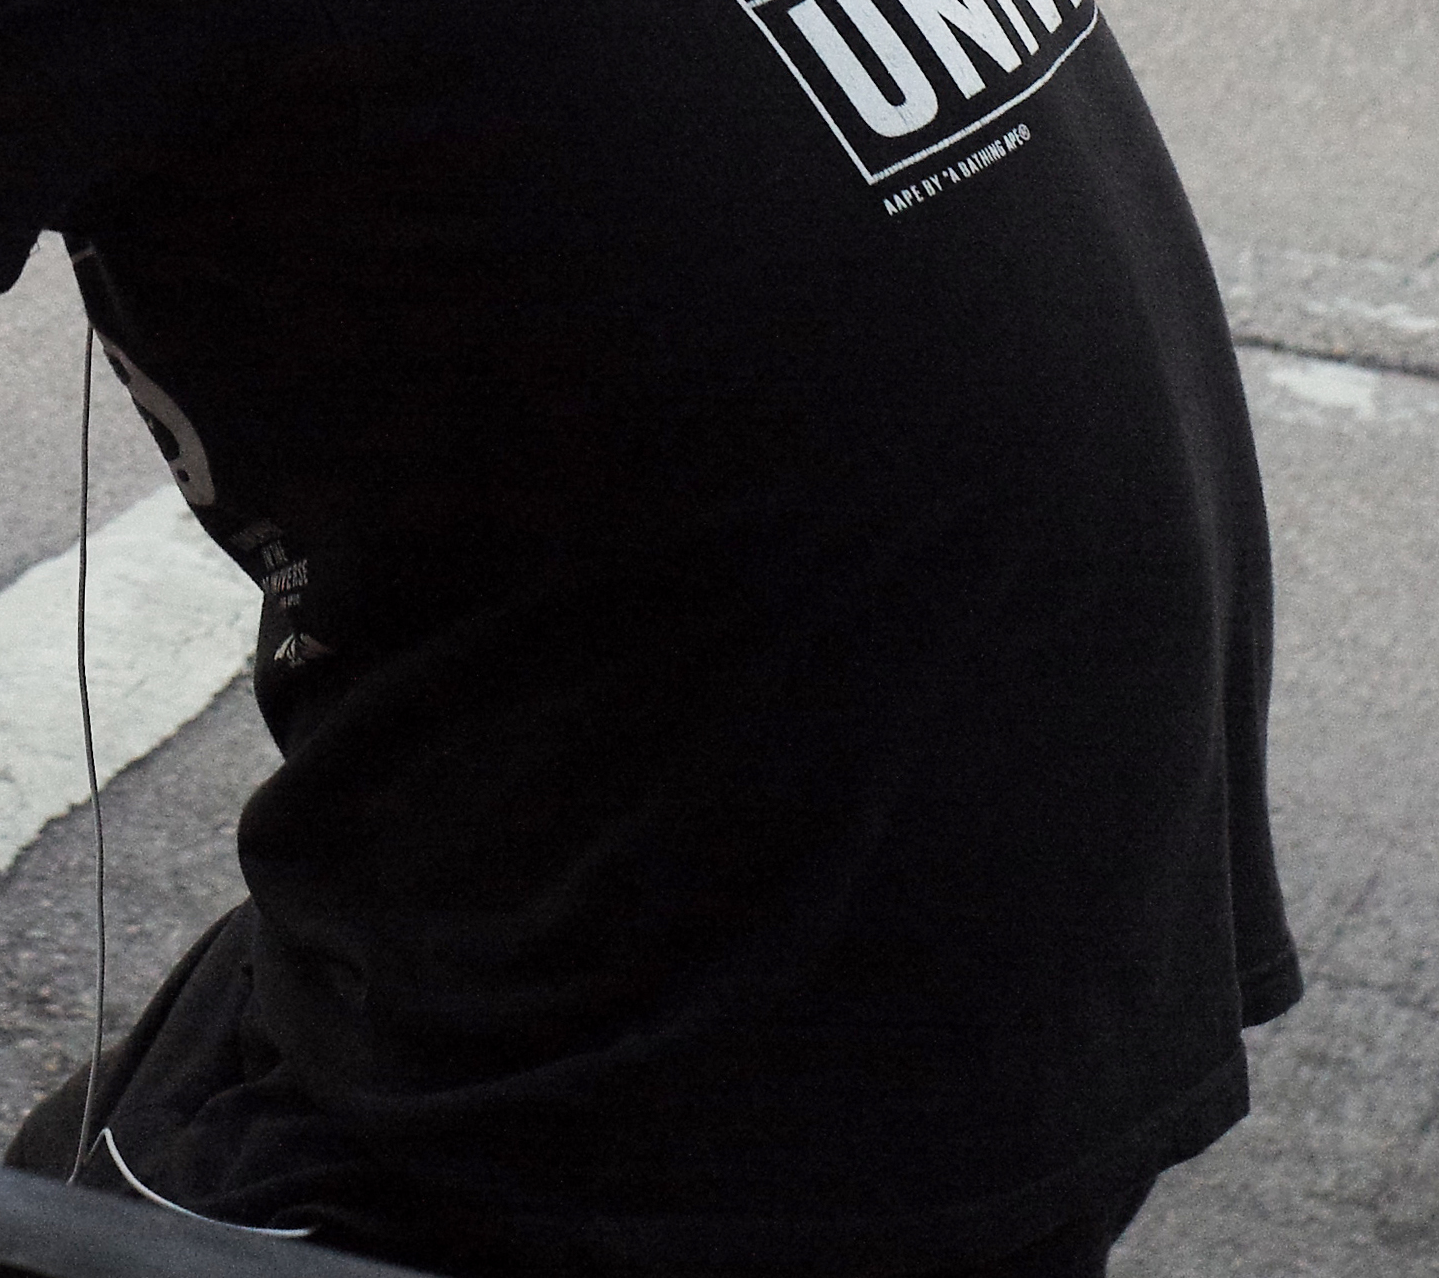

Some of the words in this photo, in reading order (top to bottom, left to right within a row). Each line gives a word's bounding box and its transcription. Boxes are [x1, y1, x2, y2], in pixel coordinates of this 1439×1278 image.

[881, 184, 924, 217] AAPE
[922, 173, 943, 198] BY
[960, 140, 1008, 179] BATHING
